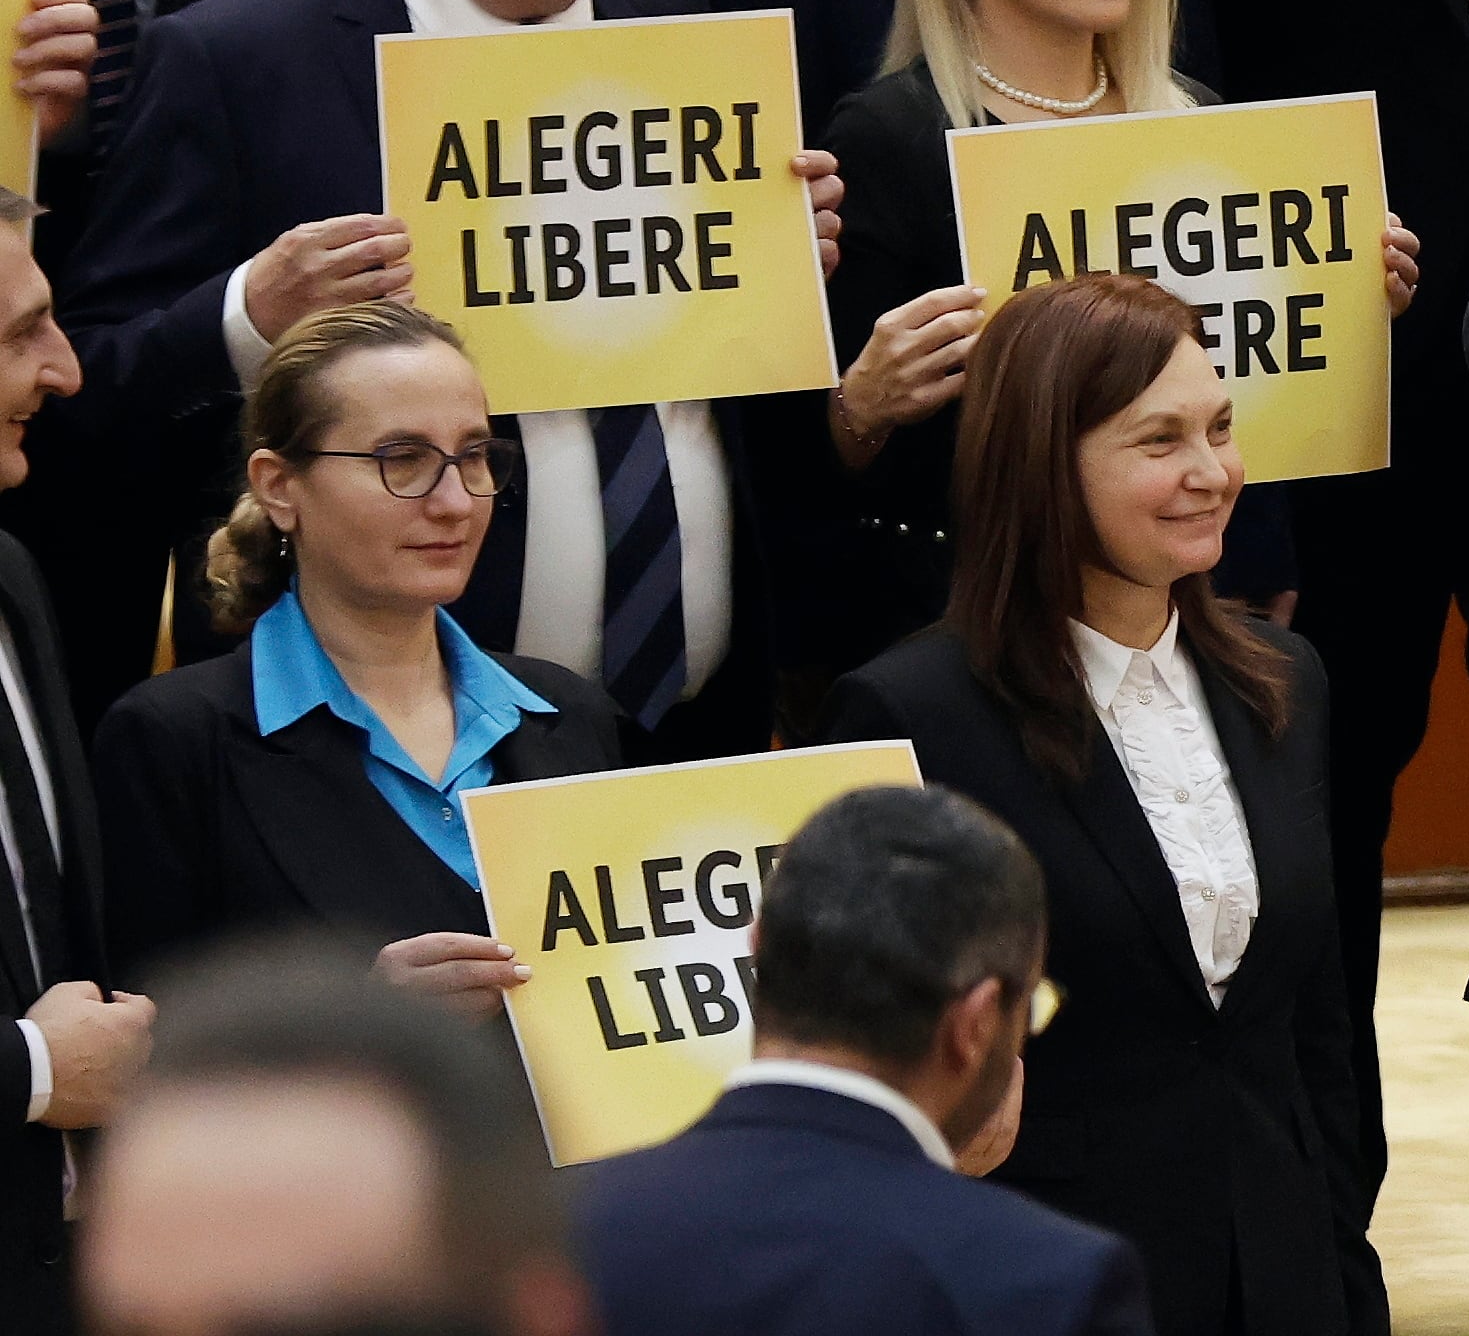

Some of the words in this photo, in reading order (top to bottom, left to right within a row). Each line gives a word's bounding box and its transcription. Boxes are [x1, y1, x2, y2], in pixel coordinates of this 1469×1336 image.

[425, 102, 761, 202] ALEGERI
[462, 211, 740, 308] LIBERE
[1012, 184, 1353, 293] ALEGERI
[541, 843, 790, 952] ALEG
[586, 954, 757, 1052] LIB
